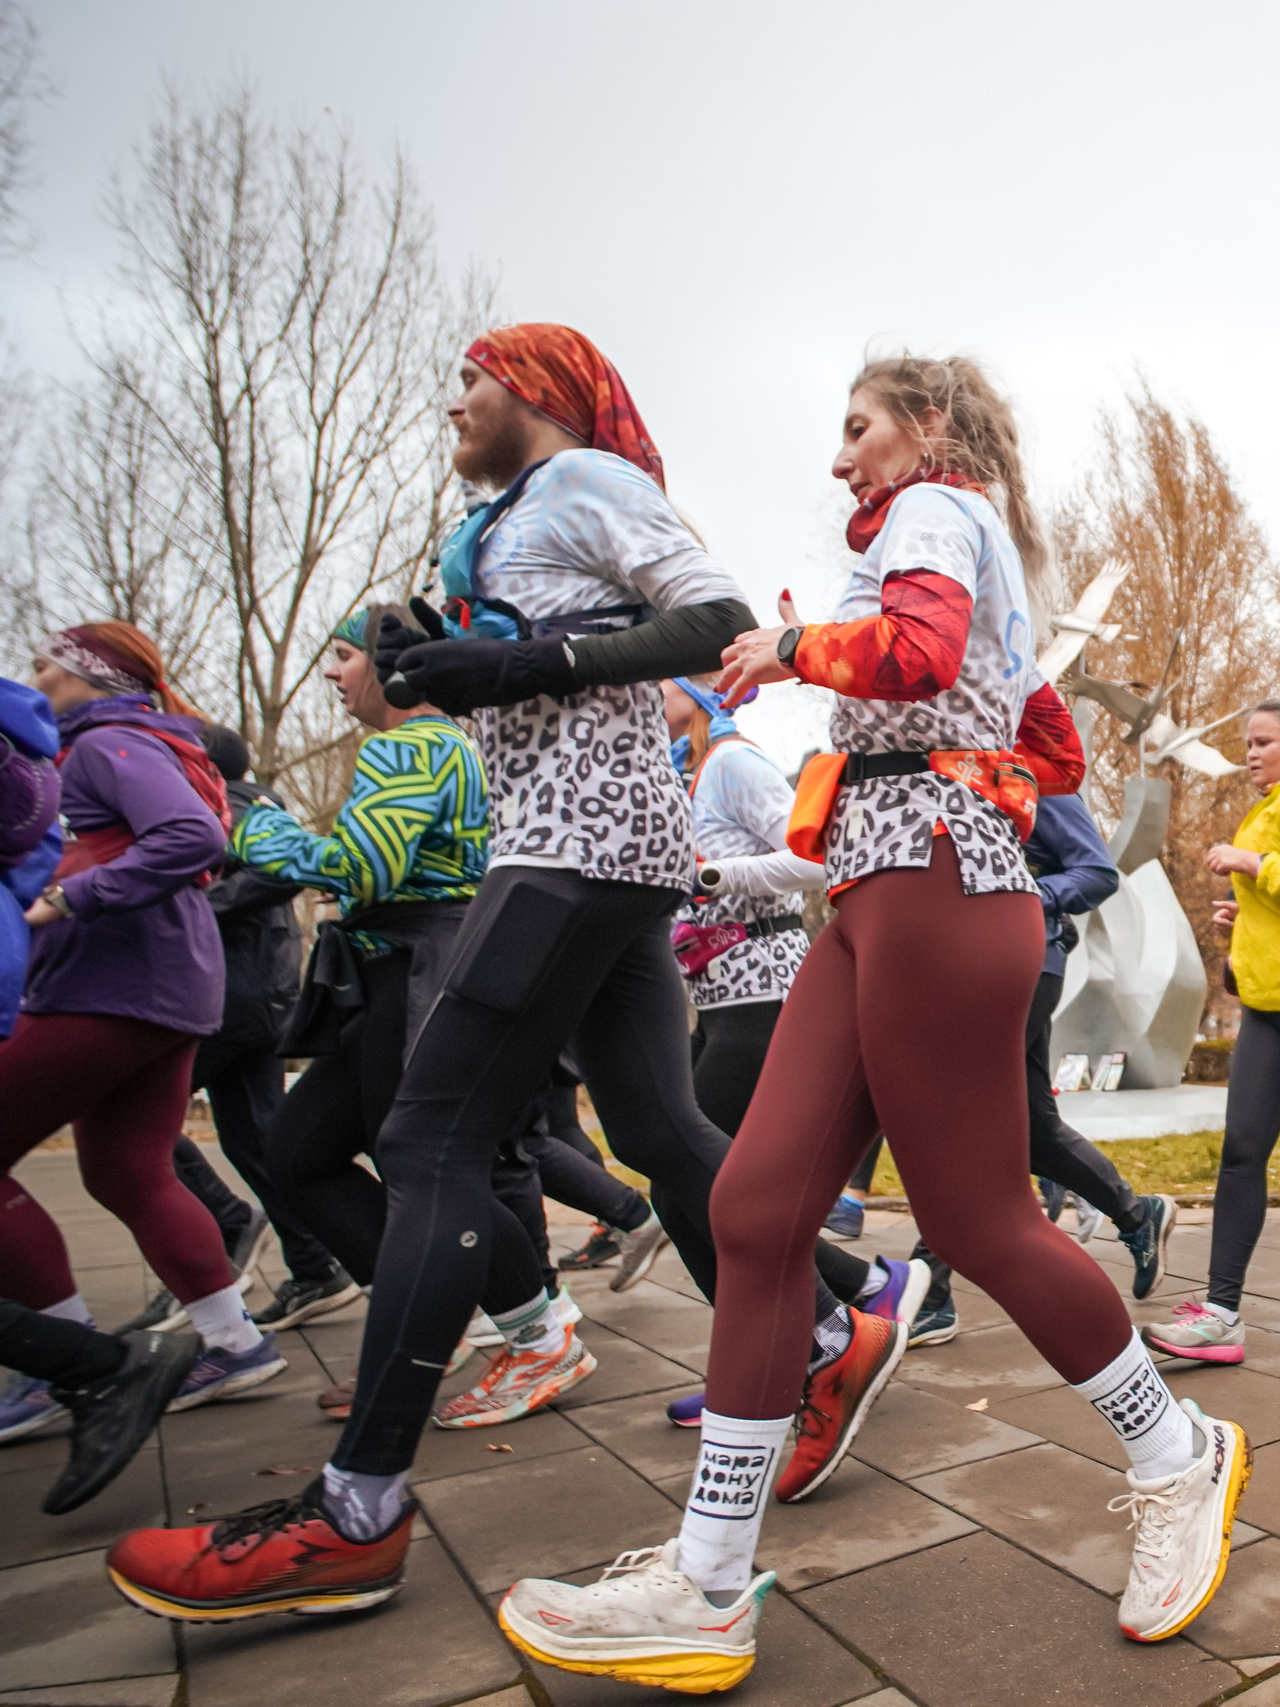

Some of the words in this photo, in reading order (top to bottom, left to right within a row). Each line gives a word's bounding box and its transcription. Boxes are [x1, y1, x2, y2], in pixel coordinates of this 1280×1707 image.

[704, 1450, 766, 1471] мара
[701, 1464, 761, 1489] фону
[695, 1486, 755, 1505] дома
